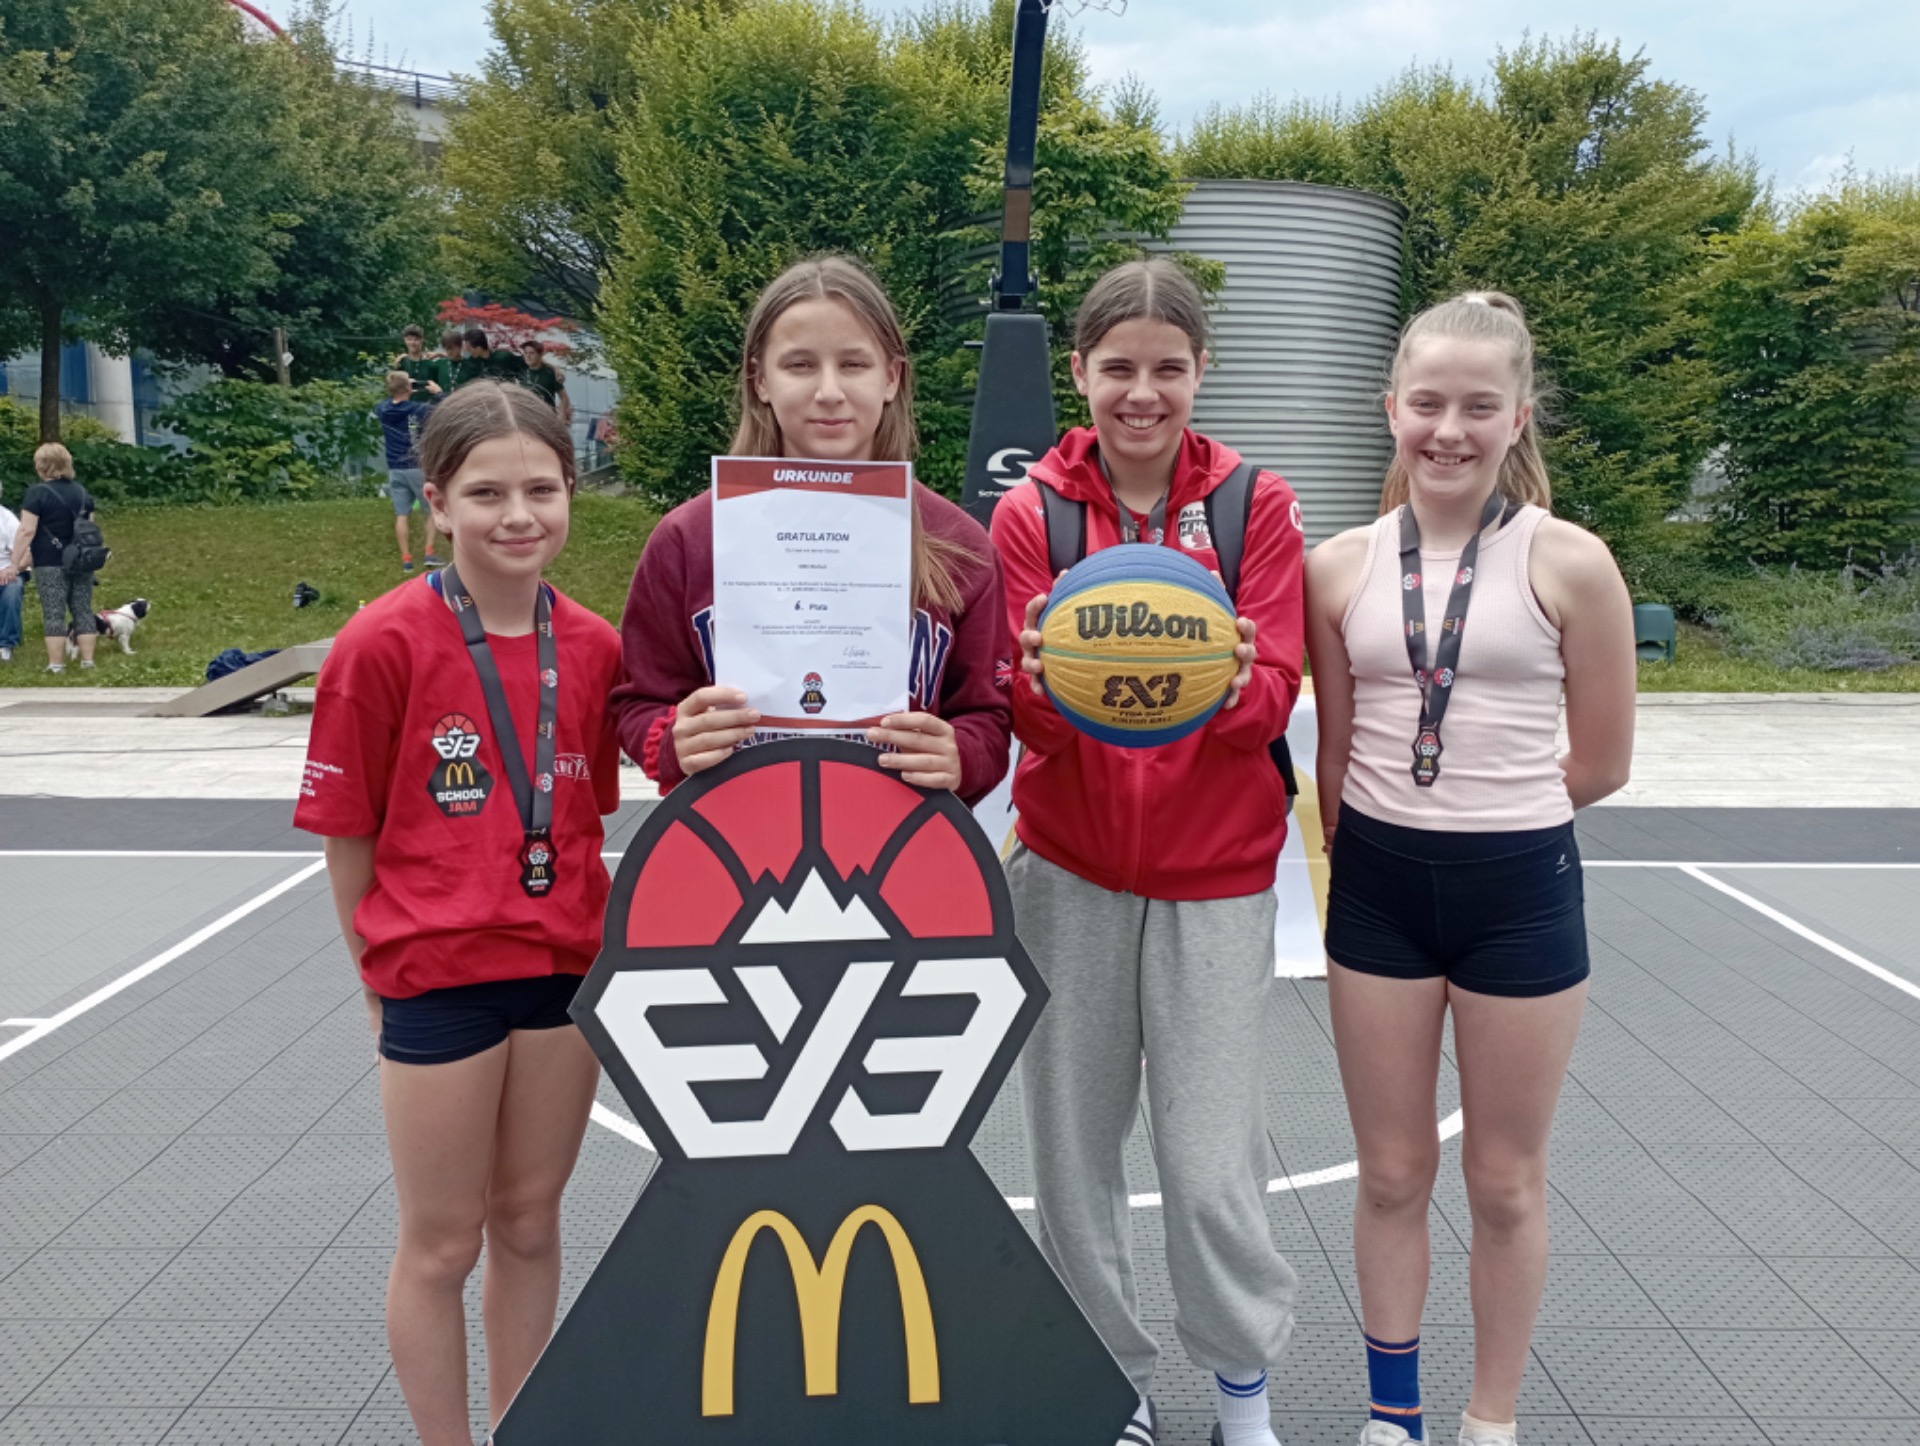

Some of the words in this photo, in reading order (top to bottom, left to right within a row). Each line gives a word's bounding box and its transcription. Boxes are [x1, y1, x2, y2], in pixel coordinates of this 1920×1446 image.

[773, 469, 853, 484] URKUNDE
[776, 532, 850, 542] GRATULATION
[1075, 601, 1210, 642] Wilson
[436, 788, 486, 803] SCHOOL
[448, 801, 477, 812] JAM
